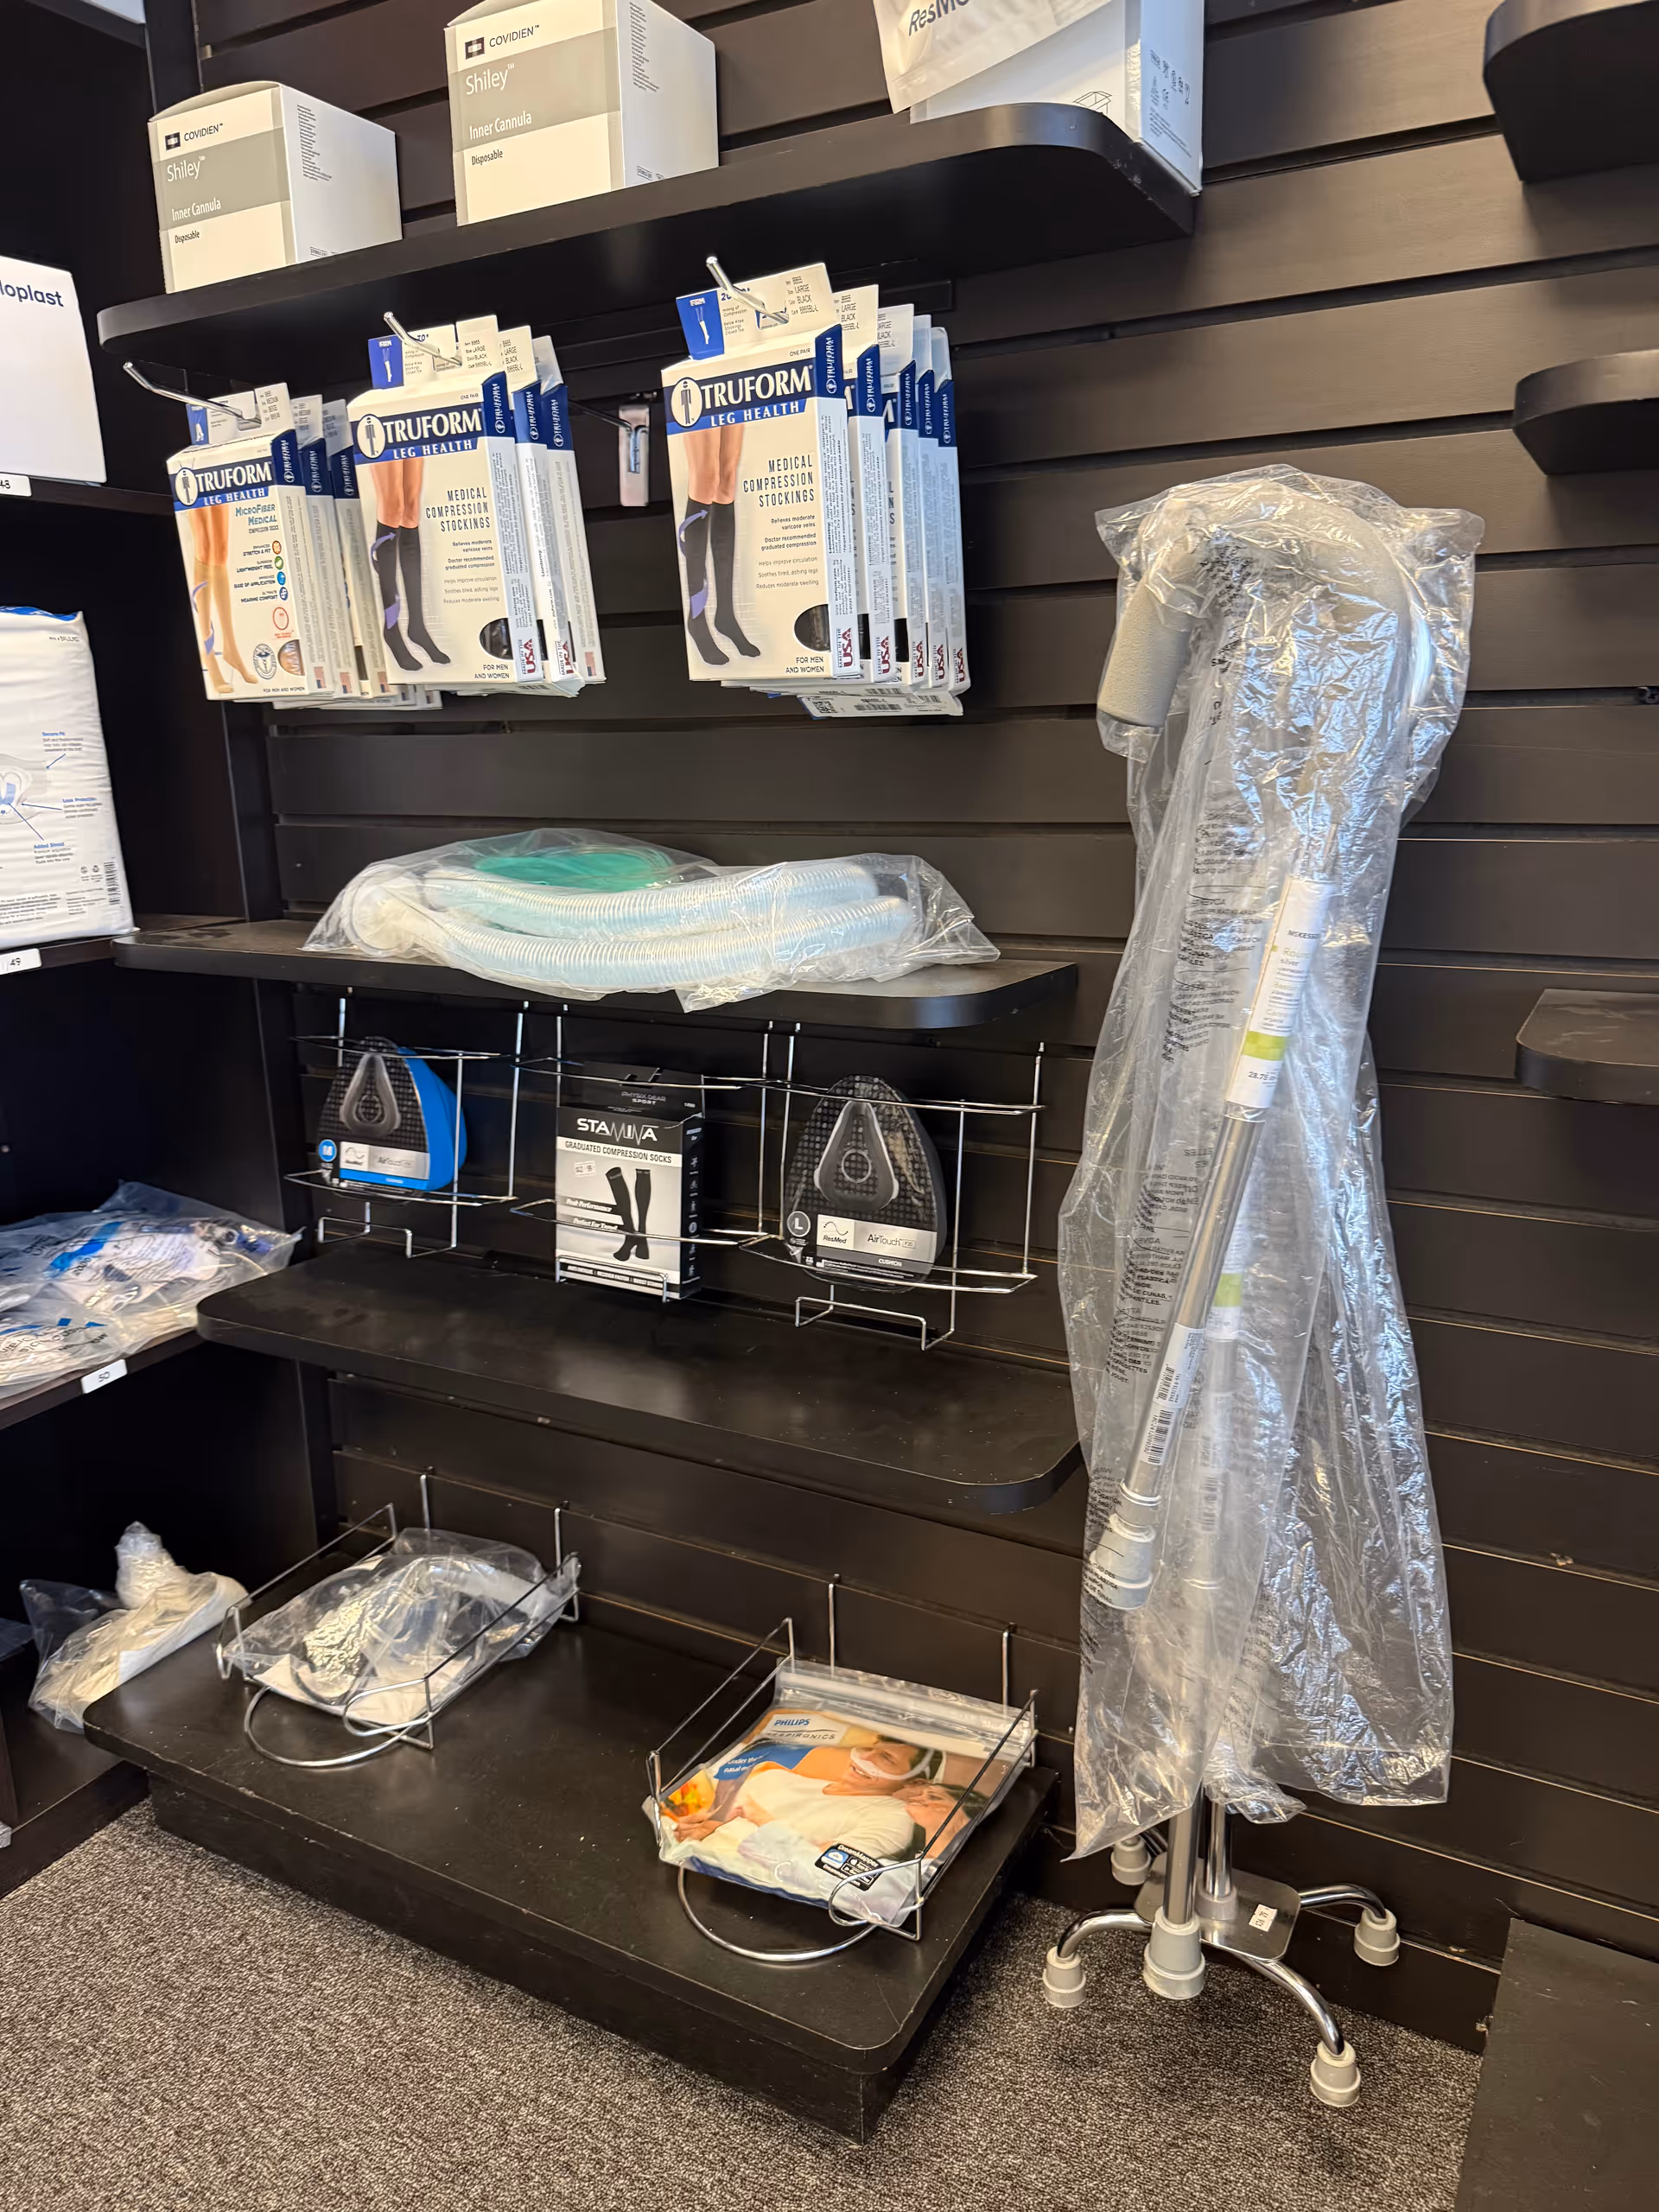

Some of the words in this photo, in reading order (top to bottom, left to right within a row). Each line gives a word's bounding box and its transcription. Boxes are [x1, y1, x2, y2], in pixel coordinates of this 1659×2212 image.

[470, 122, 493, 140] Inner
[494, 111, 531, 133] Cannula
[472, 149, 503, 165] Disposable
[172, 207, 191, 221] Inner
[192, 198, 221, 217] Cannula
[175, 230, 200, 244] Disposable
[795, 284, 810, 293] LARGE
[798, 295, 812, 304] BLACK
[842, 303, 856, 312] LARGE
[842, 313, 855, 321] BLACK
[505, 346, 517, 355] LARGE
[826, 338, 836, 378] TRUFORM
[866, 359, 874, 398] TRUFORM
[493, 383, 505, 425] TRUFORM
[526, 391, 537, 428] TRUFORM
[710, 412, 735, 427] LEG
[743, 401, 799, 421] HEALTH
[551, 399, 563, 436] TRUFORM
[281, 440, 293, 474] TRUFORM
[393, 446, 416, 460] LEG
[423, 439, 472, 454] HEALTH
[310, 450, 319, 482] TRUFORM
[340, 455, 350, 487] TRUFORM
[769, 454, 812, 473] MEDICAL
[743, 472, 813, 493] COMPRESSION
[204, 495, 224, 505] LEG
[226, 488, 265, 502] HEALTH
[448, 487, 486, 501] MEDICAL
[760, 489, 814, 507] STOCKINGS
[426, 502, 488, 518] COMPRESSION
[249, 515, 276, 526] MEDICAL
[441, 517, 490, 531] STOCKINGS
[523, 639, 536, 674] USA
[842, 627, 853, 667] USA
[881, 636, 890, 674] USA
[577, 1118, 659, 1146] STAMINA
[565, 1141, 601, 1154] GRADUATED
[603, 1147, 648, 1160] COMPRESSION
[650, 1154, 671, 1163] SOCKS
[574, 1217, 591, 1226] Perfect
[795, 1217, 804, 1230] L
[823, 1235, 847, 1244] ResMed
[879, 1258, 903, 1267] CUSHION
